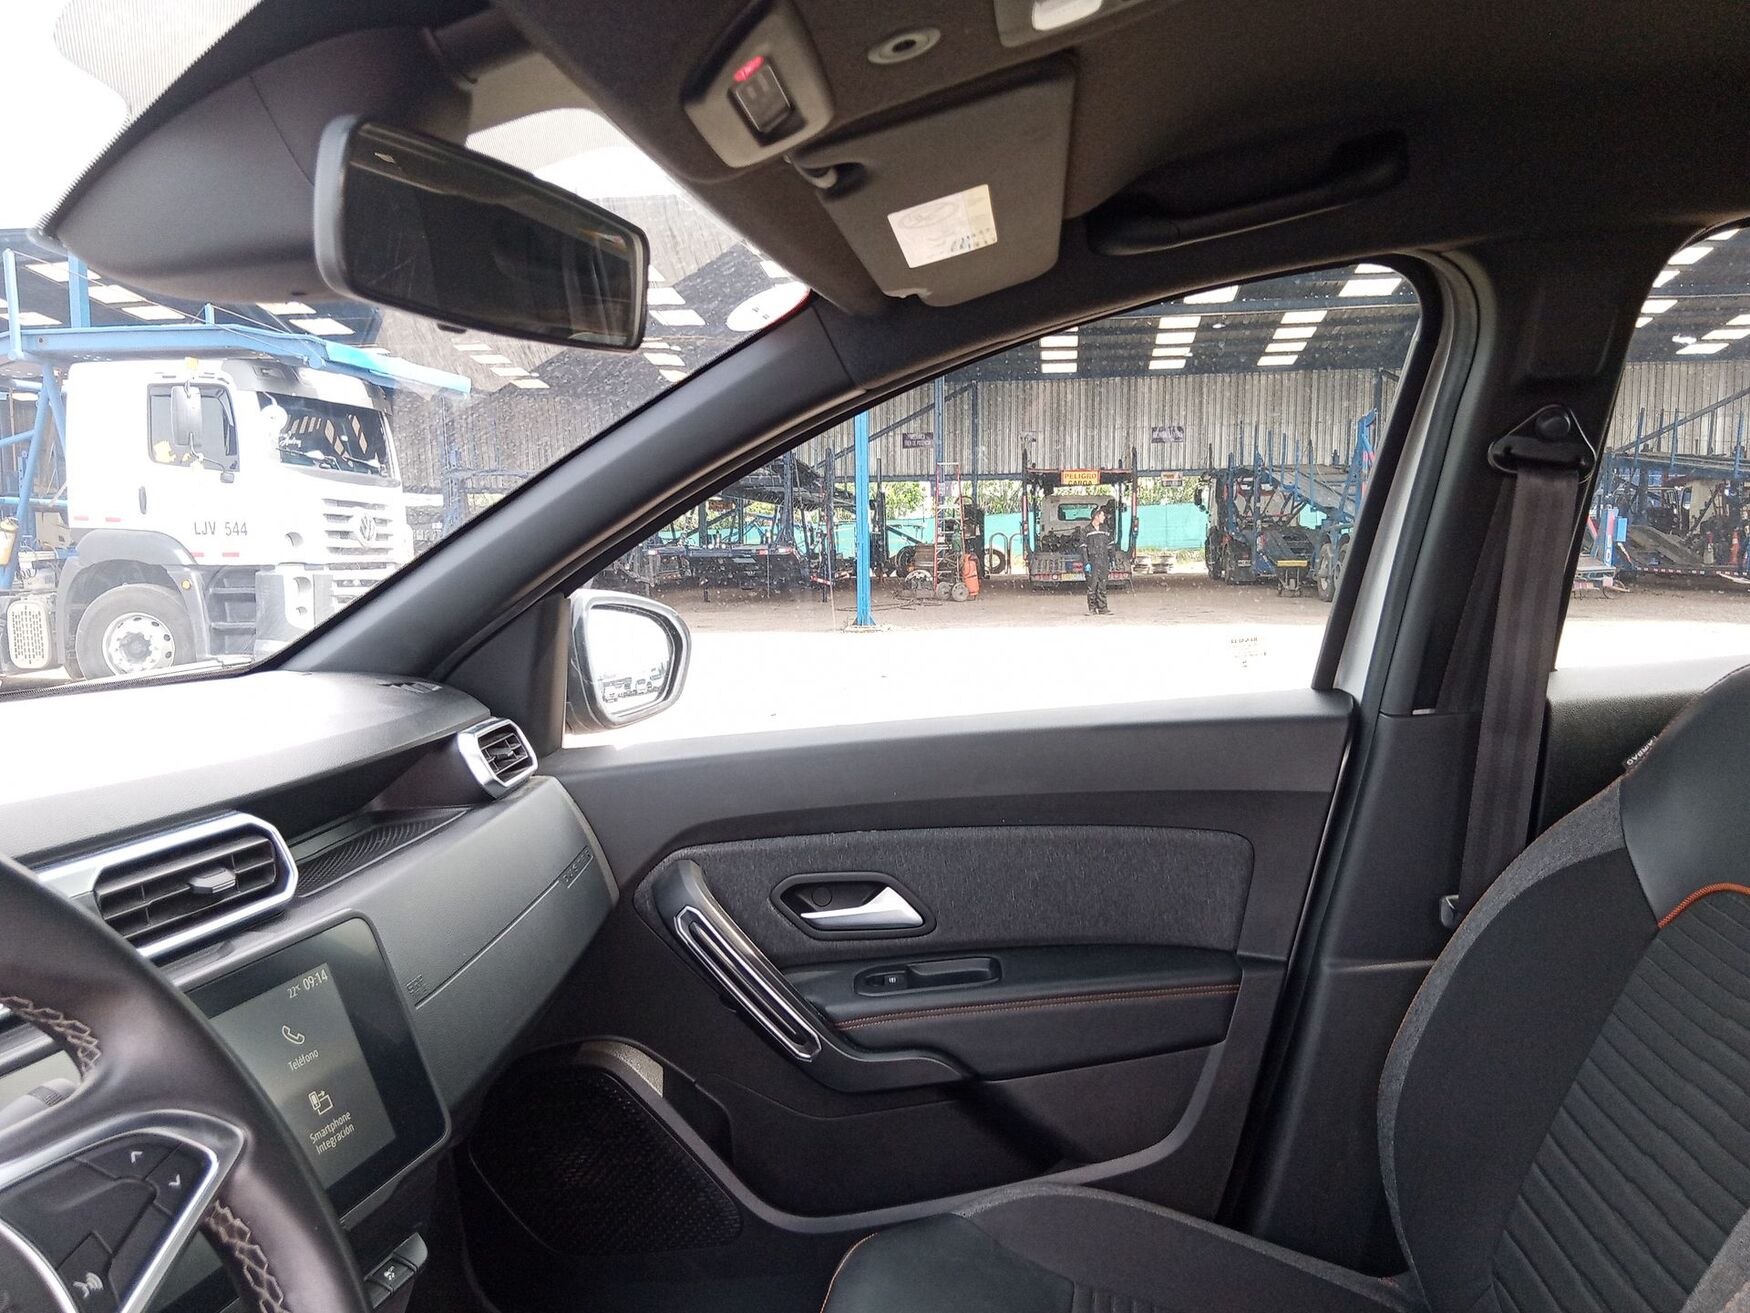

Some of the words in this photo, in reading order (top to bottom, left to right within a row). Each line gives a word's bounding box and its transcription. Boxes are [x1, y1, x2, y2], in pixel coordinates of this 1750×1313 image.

[194, 520, 216, 535] LJV
[224, 521, 248, 536] 544
[302, 968, 329, 991] 09:14
[287, 1048, 320, 1071] Teléfono
[309, 1111, 352, 1144] Smartphone
[315, 1123, 355, 1156] Integración
